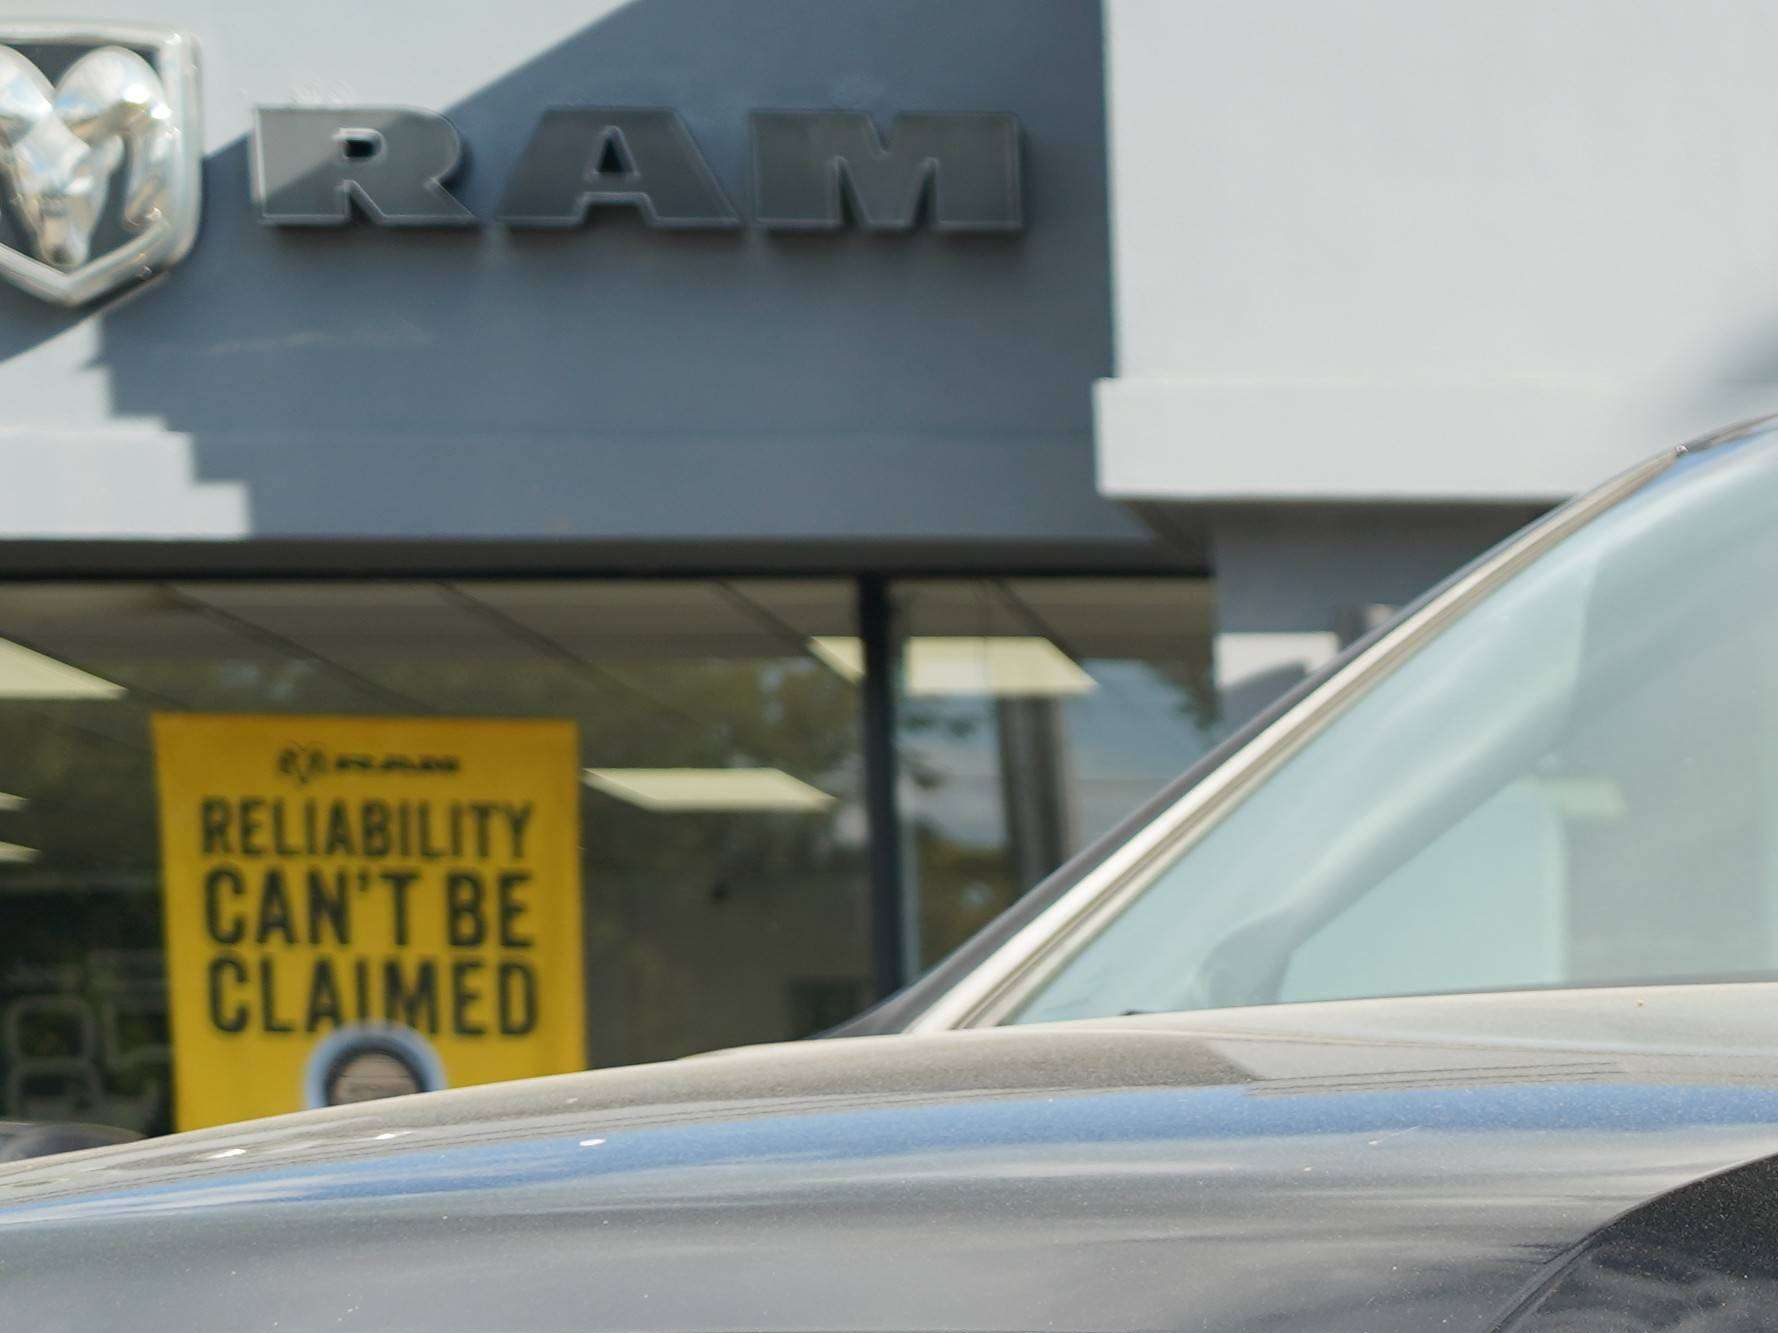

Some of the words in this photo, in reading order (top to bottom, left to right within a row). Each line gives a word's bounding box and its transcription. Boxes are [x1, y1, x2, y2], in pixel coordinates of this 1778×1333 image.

[253, 104, 1024, 231] RAM
[200, 795, 534, 860] RELIABILITY
[205, 868, 421, 948] CAN'T
[446, 873, 534, 949] BE
[207, 954, 540, 1036] CLAIMED
